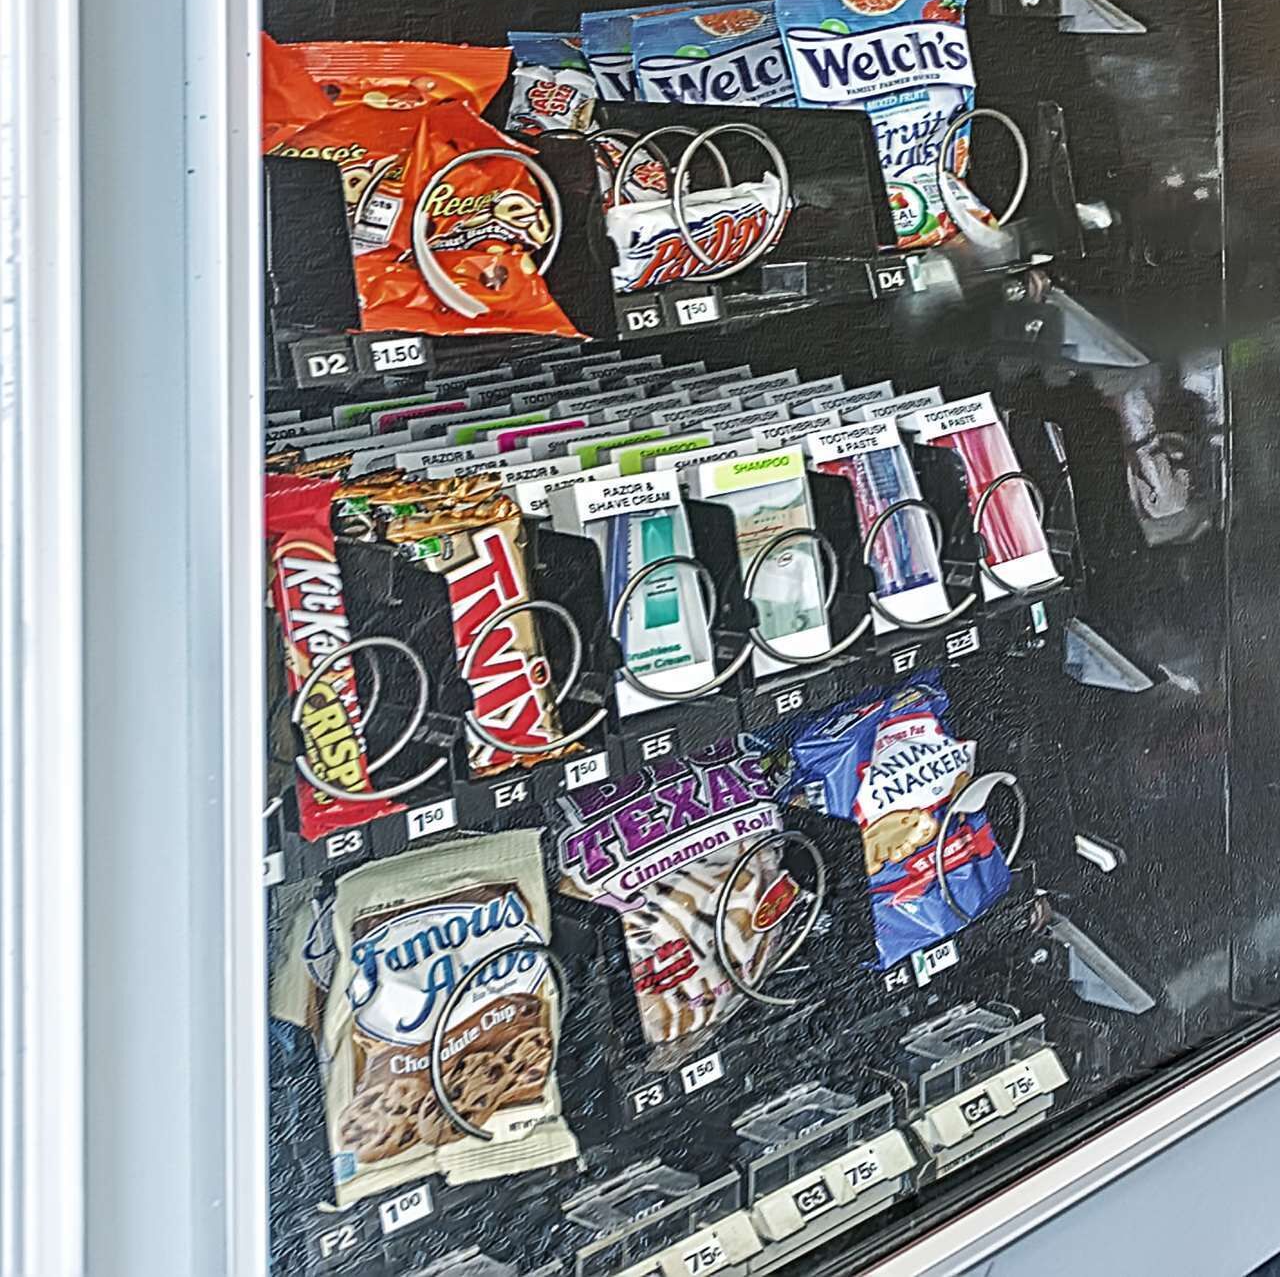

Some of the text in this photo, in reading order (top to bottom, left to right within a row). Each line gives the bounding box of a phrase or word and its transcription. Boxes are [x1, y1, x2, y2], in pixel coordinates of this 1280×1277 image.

[796, 31, 968, 90] Welch's
[878, 271, 905, 290] D4
[627, 310, 659, 331] D3
[309, 354, 348, 378] D2
[924, 400, 984, 424] TOOTHBRUSH
[950, 413, 978, 428] PASTE
[761, 417, 831, 439] TOOTHBRUSH
[818, 423, 889, 447] TOOTHBRUSH
[846, 436, 880, 453] PASTE
[505, 467, 549, 484] RAZOR
[734, 455, 790, 475] SHAMPOO
[588, 490, 672, 514] SHAVE CREAM
[603, 483, 644, 499] RAZOR
[776, 690, 804, 715] E6
[641, 735, 674, 760] E5
[872, 744, 971, 810] SNACKERS
[495, 781, 529, 807] E4
[413, 809, 446, 834] 150
[566, 755, 775, 879] TEXAS
[327, 832, 364, 859] E3
[619, 807, 774, 891] Cinnamon Roll
[350, 890, 528, 1011] Famous
[885, 972, 909, 991] F4
[482, 1003, 518, 1030] Chip
[633, 1089, 664, 1114] F3
[964, 1098, 990, 1123] G4
[385, 1192, 422, 1222] 100
[798, 1185, 827, 1212] G3
[320, 1227, 358, 1258] F2
